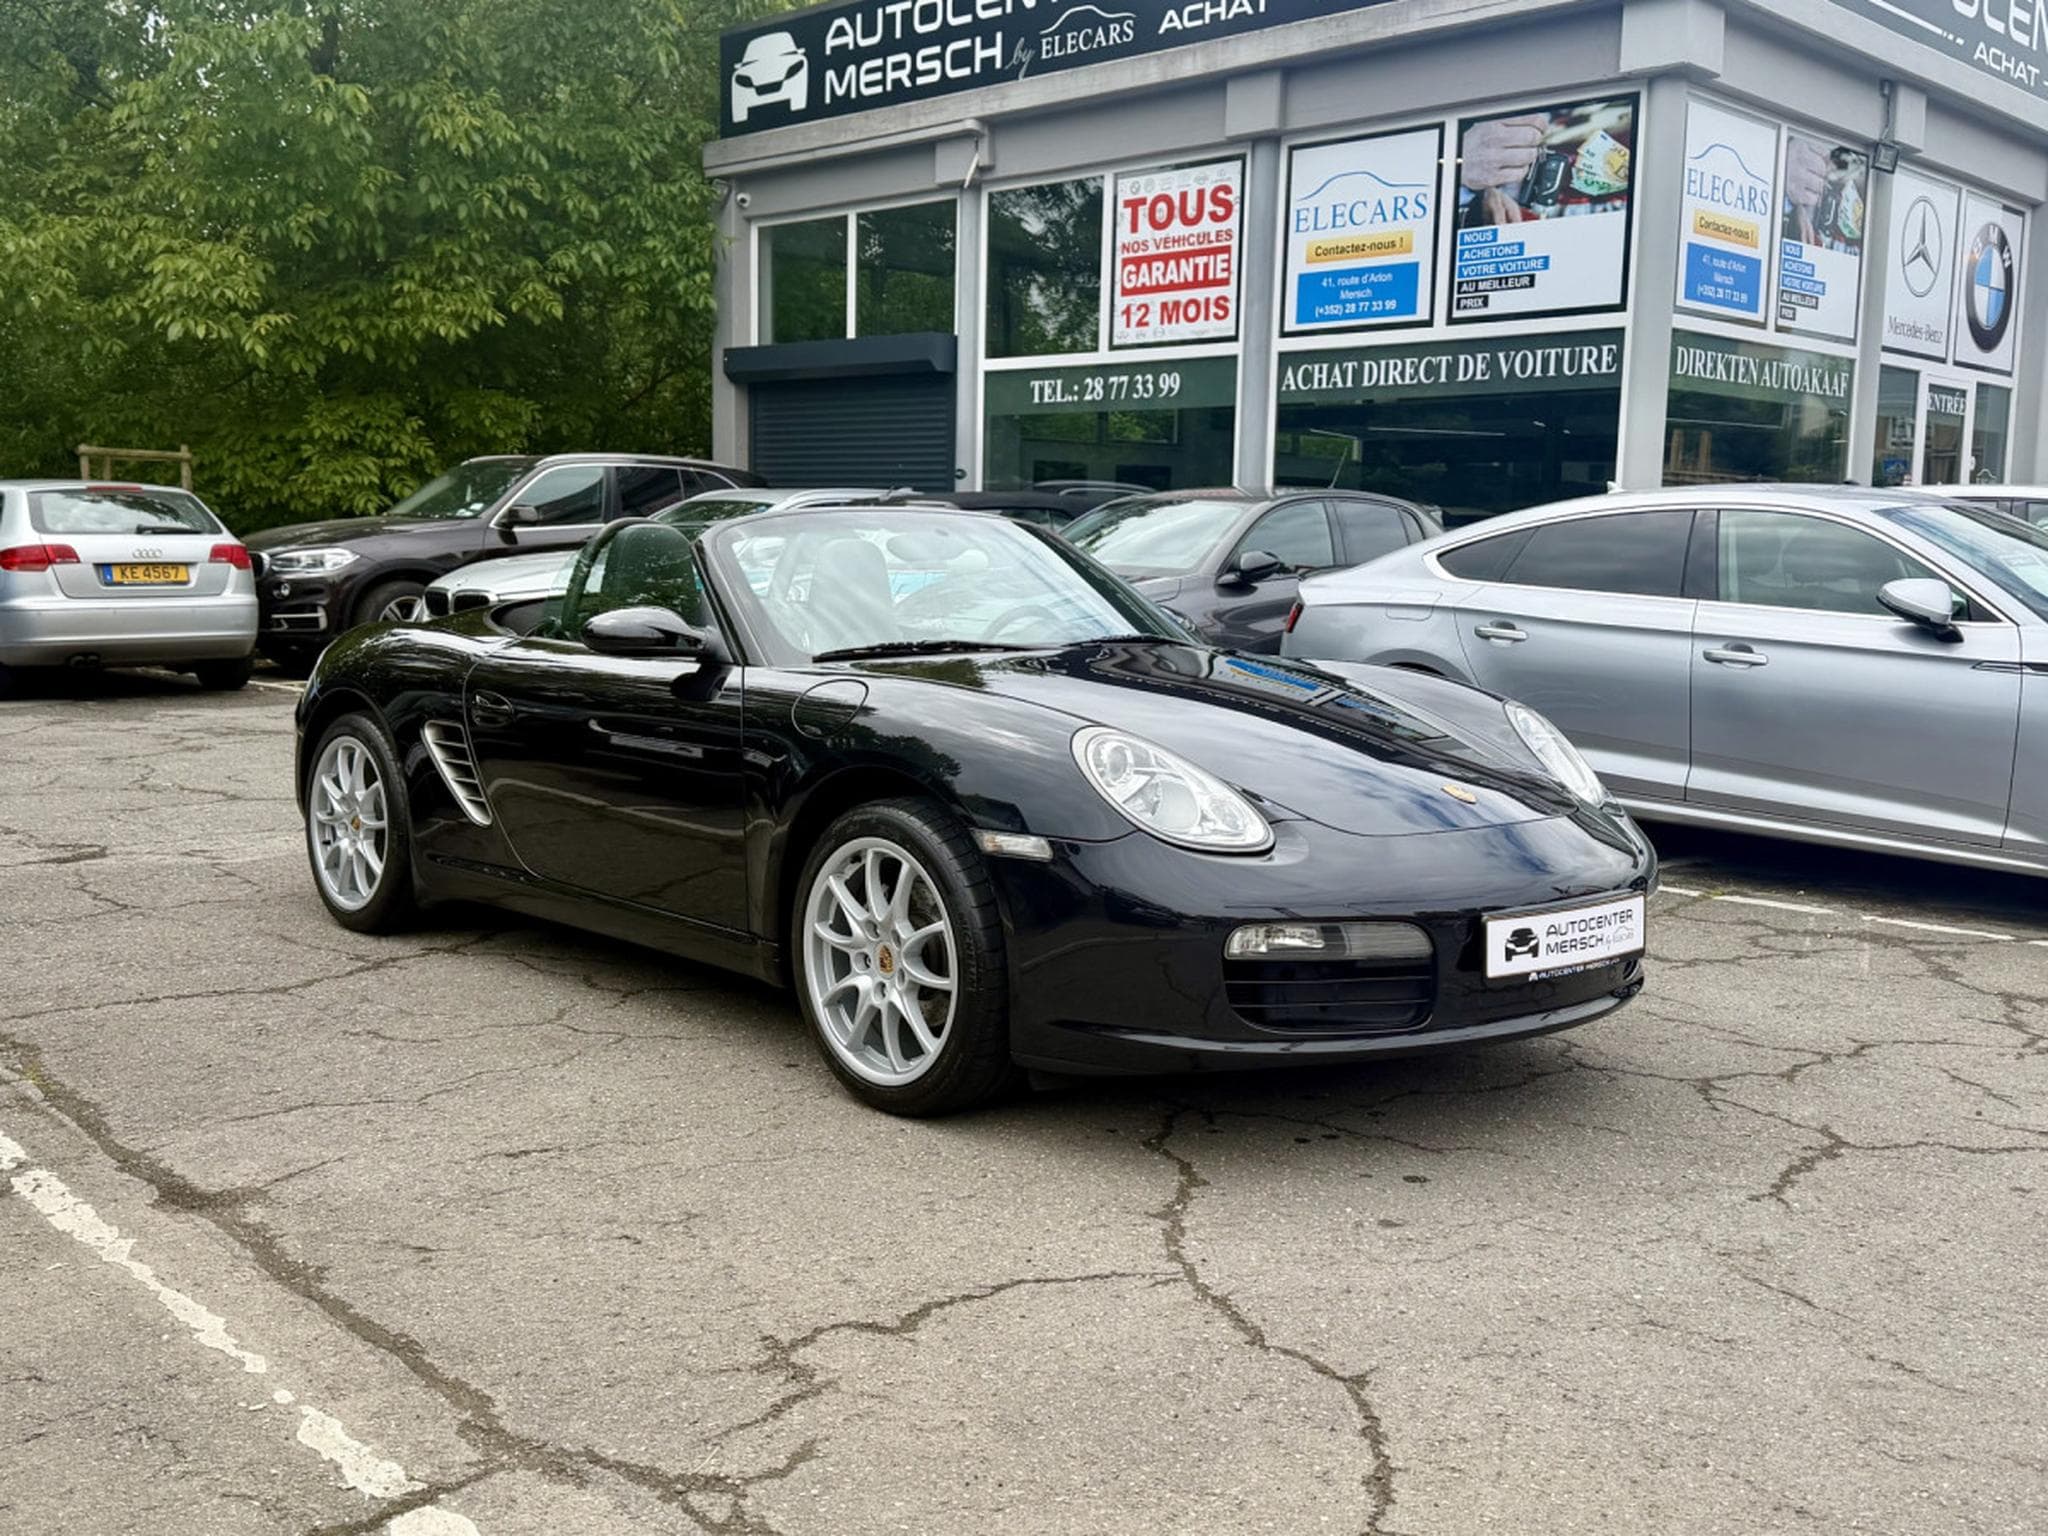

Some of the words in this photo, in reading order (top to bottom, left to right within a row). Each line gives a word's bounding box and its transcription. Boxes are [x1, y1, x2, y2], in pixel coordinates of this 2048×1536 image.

[825, 31, 1002, 104] MERSCH
[1005, 37, 1035, 81] by
[1040, 20, 1135, 60] ELECARS
[1974, 41, 2040, 87] ACHAT
[1687, 167, 1769, 216] ELECARS
[1123, 183, 1234, 234] TOUS
[1295, 192, 1428, 234] ELECARS
[1121, 239, 1149, 255] NOS
[1314, 239, 1396, 258] Contactez-nous
[1463, 231, 1493, 243] NOUS
[1973, 223, 2012, 269] BMW
[1463, 244, 1519, 260] ACHETONS
[1122, 253, 1229, 289] GARANTIE
[1338, 275, 1360, 286] route
[1462, 263, 1496, 276] VOTRE
[1499, 258, 1545, 273] VOITURE
[1461, 281, 1476, 292] AU
[1477, 276, 1530, 291] MEILLEUR
[1121, 303, 1149, 328] 12
[1160, 295, 1230, 325] MOIS
[1345, 303, 1356, 314] 28
[1358, 301, 1369, 312] 77
[1372, 300, 1383, 311] 33
[1384, 299, 1397, 310] 99
[1460, 297, 1484, 309] PRIX
[1888, 315, 1943, 344] Mercedes-Benz
[1282, 361, 1358, 391] ACHAT
[1362, 356, 1451, 386] DIRECT
[1456, 353, 1491, 381] DE
[1498, 345, 1617, 380] VOITURE
[1676, 346, 1759, 385] DIREKTEN
[1760, 361, 1849, 397] AUTOAKAAF
[1031, 379, 1078, 404] TEL.:
[1083, 377, 1104, 400] 28
[1108, 375, 1129, 400] 77
[1132, 373, 1154, 398] 33
[1158, 372, 1180, 397] 99
[1927, 391, 1967, 416] ENTRÉE
[120, 566, 140, 580] KE
[143, 565, 180, 580] 4567
[1546, 908, 1633, 937] AUTOCENTER
[1546, 934, 1603, 955] MERSCH
